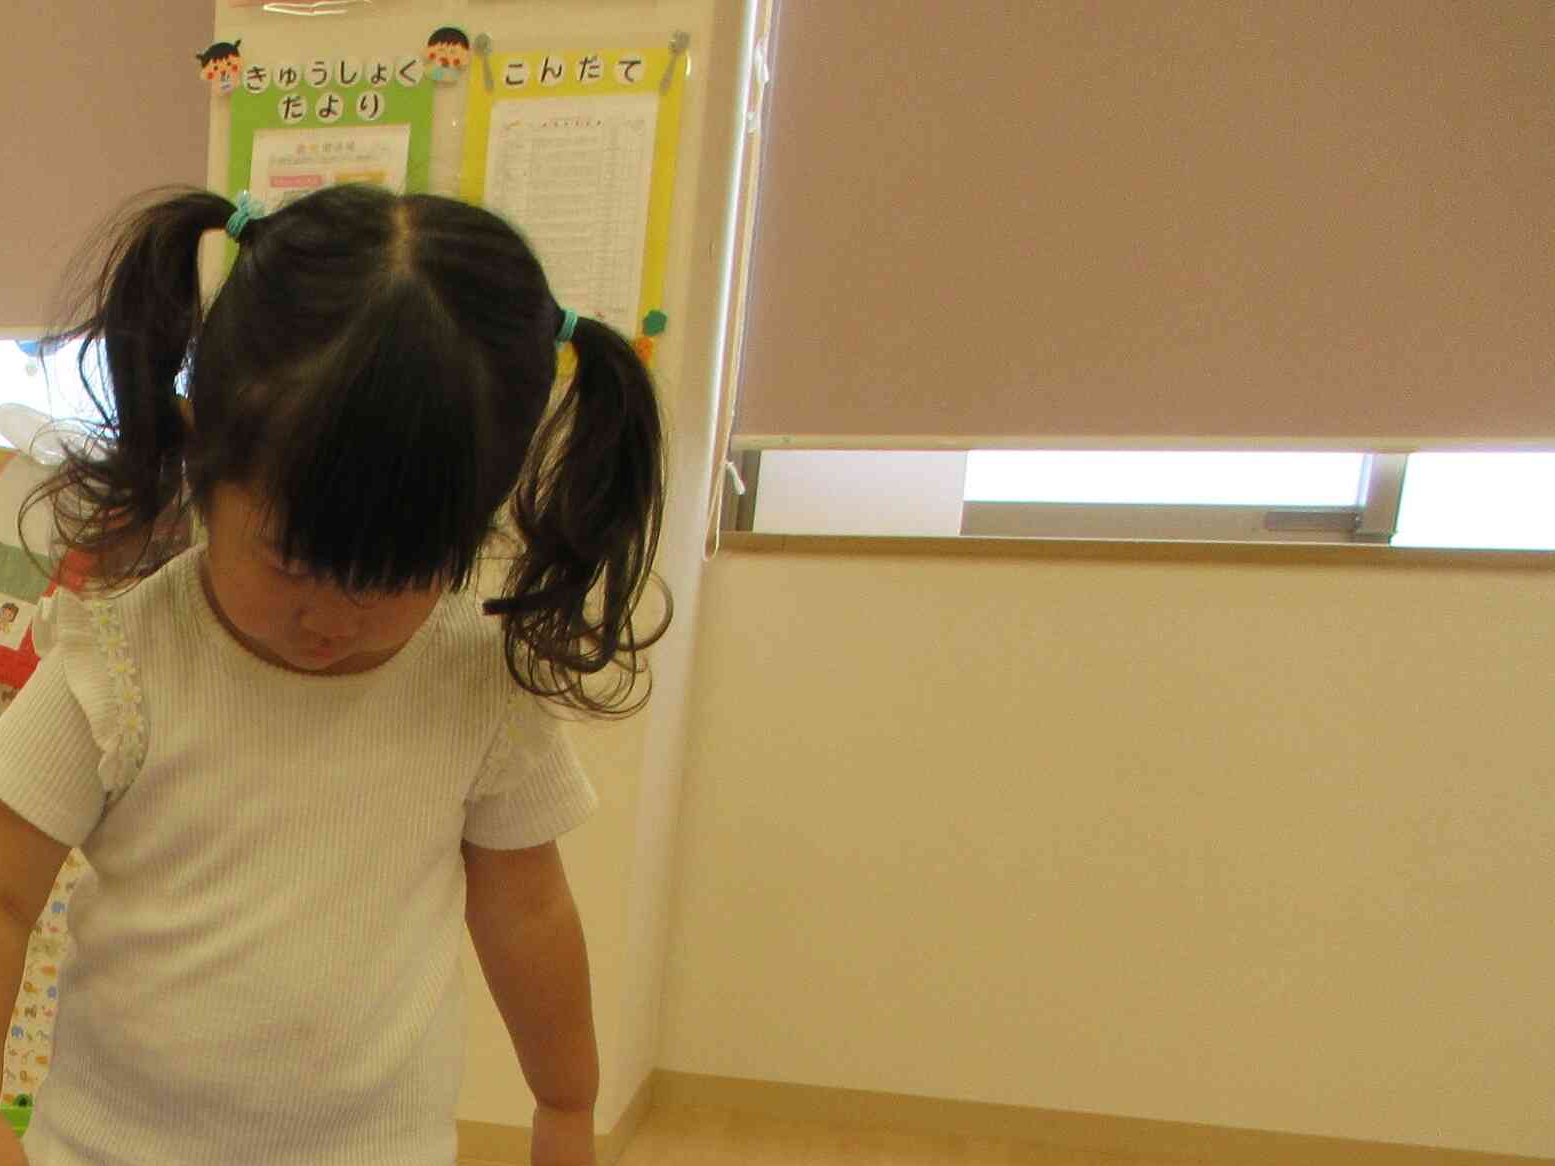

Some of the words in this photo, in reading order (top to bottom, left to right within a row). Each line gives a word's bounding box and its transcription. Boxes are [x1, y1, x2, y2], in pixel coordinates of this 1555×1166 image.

[246, 59, 417, 91] きゅうしょく
[505, 55, 642, 86] こんだて
[282, 93, 379, 121] だより
